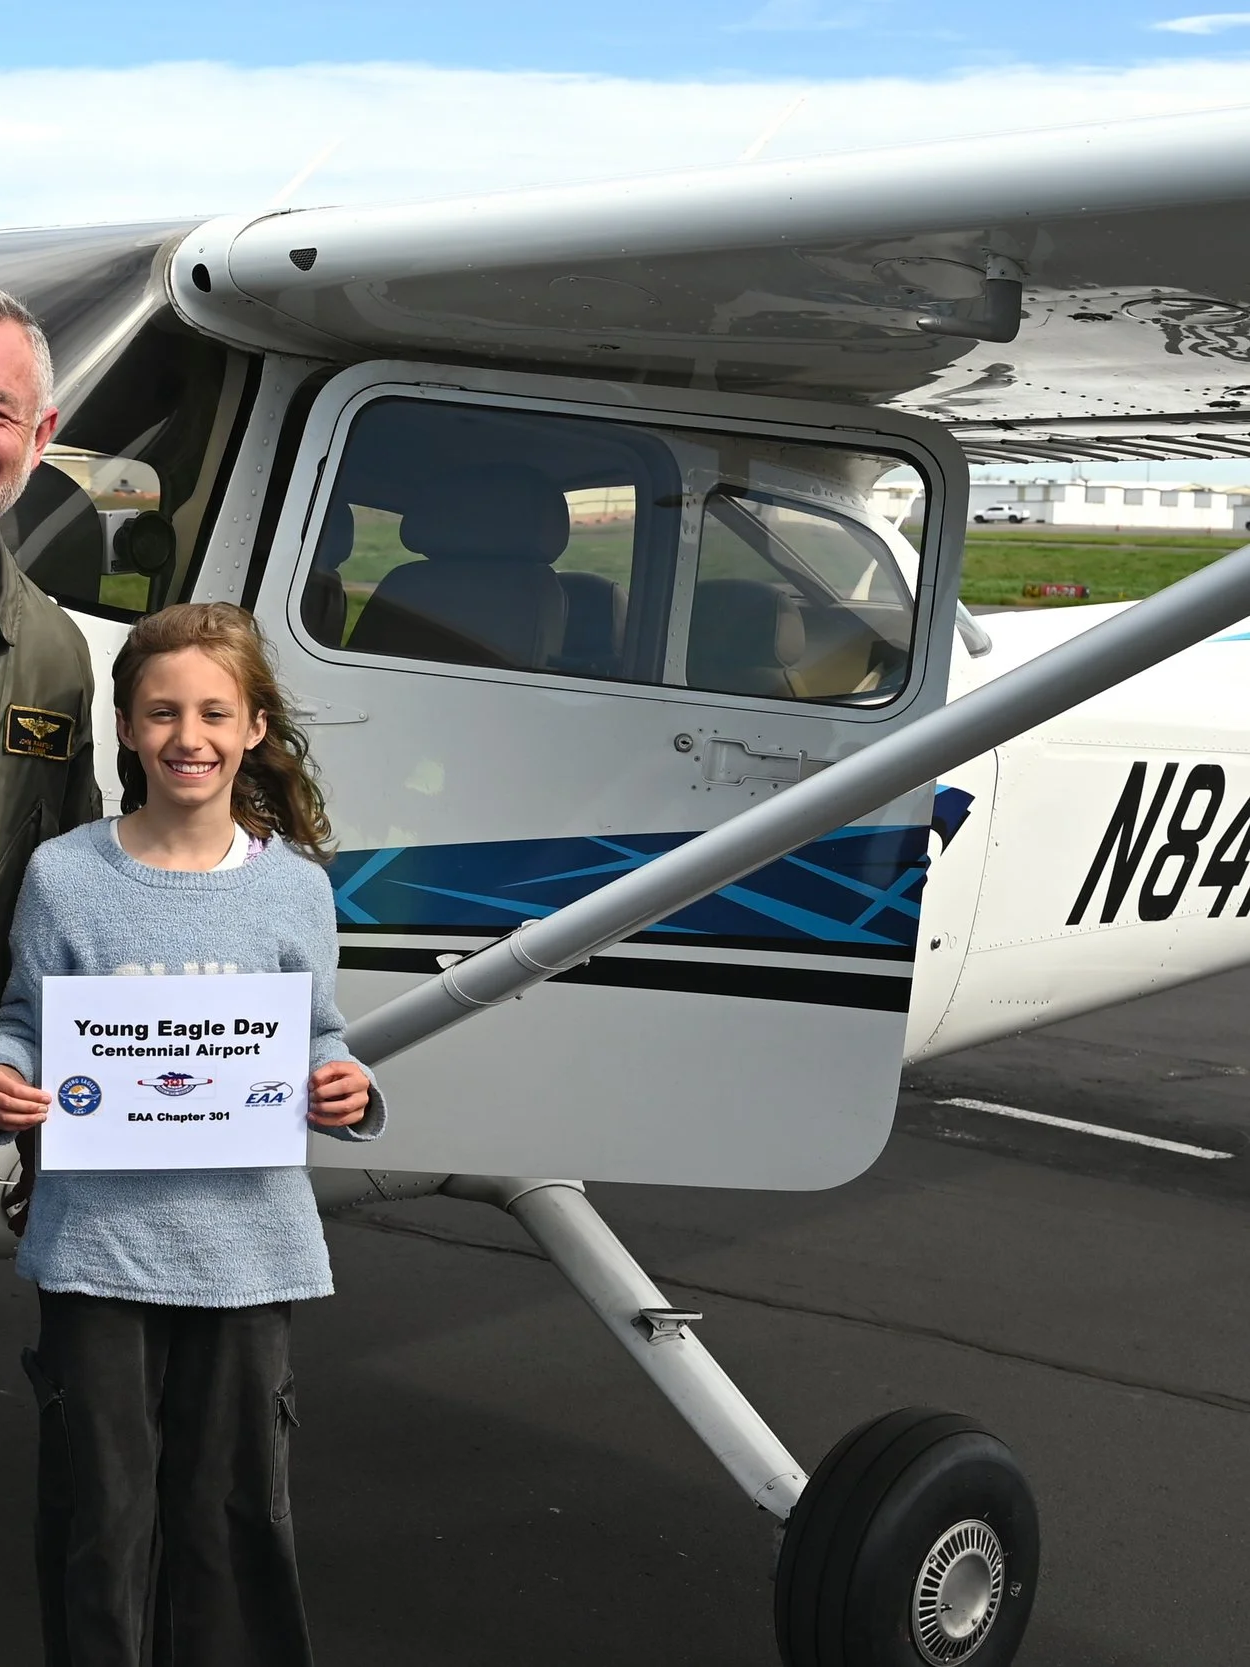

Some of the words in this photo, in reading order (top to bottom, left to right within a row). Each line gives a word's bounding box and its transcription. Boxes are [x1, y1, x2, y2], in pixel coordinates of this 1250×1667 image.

[1065, 761, 1250, 926] N84
[74, 1019, 149, 1041] Young
[157, 1020, 226, 1040] Eagle
[234, 1019, 279, 1039] Day
[91, 1043, 190, 1057] Centennial
[196, 1043, 261, 1059] Airport
[61, 1078, 79, 1092] YOUNG
[245, 1092, 284, 1104] EAA
[127, 1112, 154, 1122] EAA
[156, 1112, 206, 1123] Chapter
[208, 1111, 230, 1121] 301
